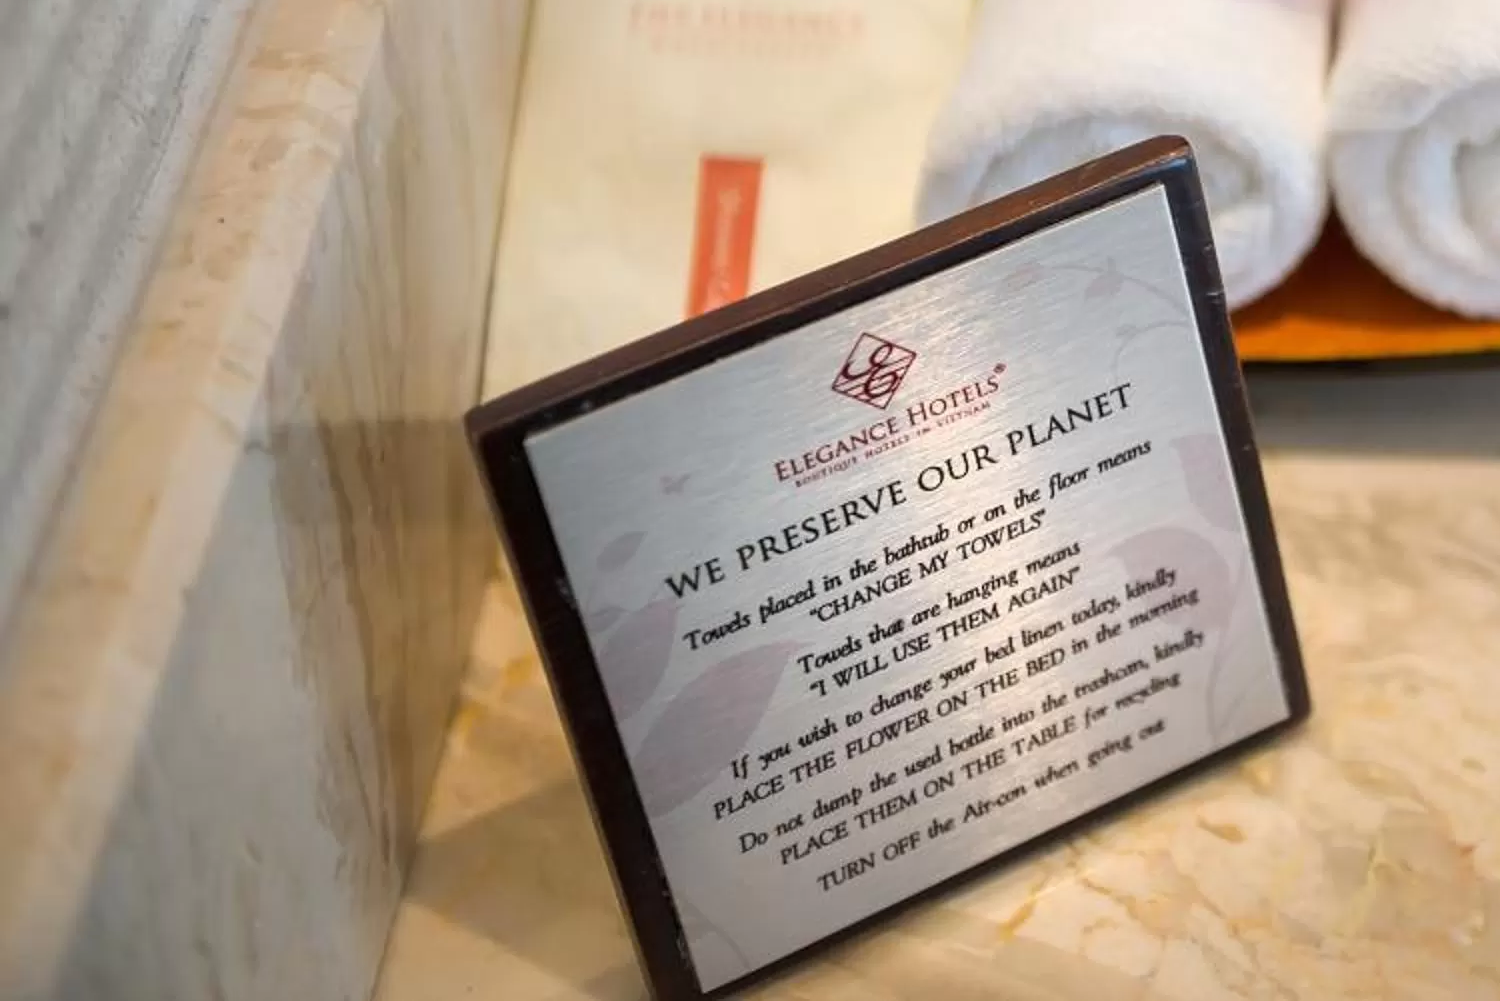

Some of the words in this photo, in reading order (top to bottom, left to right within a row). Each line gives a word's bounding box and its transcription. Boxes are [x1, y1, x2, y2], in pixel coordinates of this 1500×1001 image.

[664, 557, 726, 599] WE
[736, 480, 907, 571] PRESERVE
[917, 444, 998, 492] OUR
[1005, 382, 1131, 456] PLANET
[774, 416, 900, 482] ELEGANCE
[683, 611, 751, 650] Towels
[759, 579, 818, 624] placed
[822, 575, 843, 592] in
[849, 558, 879, 581] the
[883, 523, 950, 566] bathtub
[957, 515, 976, 534] or
[983, 504, 1007, 522] on
[1013, 488, 1041, 510] the
[1048, 467, 1090, 500] floor
[1097, 441, 1151, 474] means
[797, 635, 863, 674] Towels
[867, 618, 905, 645] that
[911, 604, 942, 626] are
[945, 569, 1019, 610] hanging
[1025, 542, 1081, 575] means
[917, 550, 949, 579] MY
[713, 774, 785, 820] PLACE
[789, 750, 837, 783] THE
[845, 707, 932, 760] FLOWER
[936, 690, 968, 717] ON
[973, 668, 1020, 699] THE
[1025, 647, 1066, 678] BED
[1071, 638, 1089, 655] in
[1095, 623, 1121, 644] the
[1128, 589, 1200, 629] morning
[731, 754, 749, 780] If
[758, 743, 792, 771] you
[797, 718, 839, 748] wish
[845, 710, 864, 728] to
[869, 678, 933, 716] change
[939, 658, 977, 690] your
[984, 636, 1016, 665] bed
[1020, 620, 1065, 648] linen
[1071, 596, 1121, 626] today,
[1125, 567, 1176, 601] kindly
[832, 654, 889, 688] WILL
[891, 632, 932, 663] USE
[935, 602, 1000, 642] THEM
[738, 832, 769, 854] Do
[774, 813, 805, 837] not
[812, 787, 863, 820] dump
[869, 772, 897, 793] the
[904, 744, 944, 778] used
[948, 724, 996, 757] bottle
[1001, 710, 1036, 733] into
[1041, 694, 1068, 715] the
[1074, 659, 1150, 699] trashcan,
[1153, 629, 1204, 663] kindly
[780, 820, 849, 865] PLACE
[853, 788, 918, 830] THEM
[923, 770, 955, 798] ON
[960, 748, 1006, 780] THE
[1010, 715, 1077, 756] TABLE
[1084, 705, 1109, 729] for
[816, 852, 875, 891] TURN
[882, 831, 921, 861] OFF
[927, 818, 956, 839] the
[963, 785, 1028, 823] Air-con
[1033, 760, 1080, 789] when
[1087, 734, 1133, 768] going
[1138, 719, 1166, 740] out
